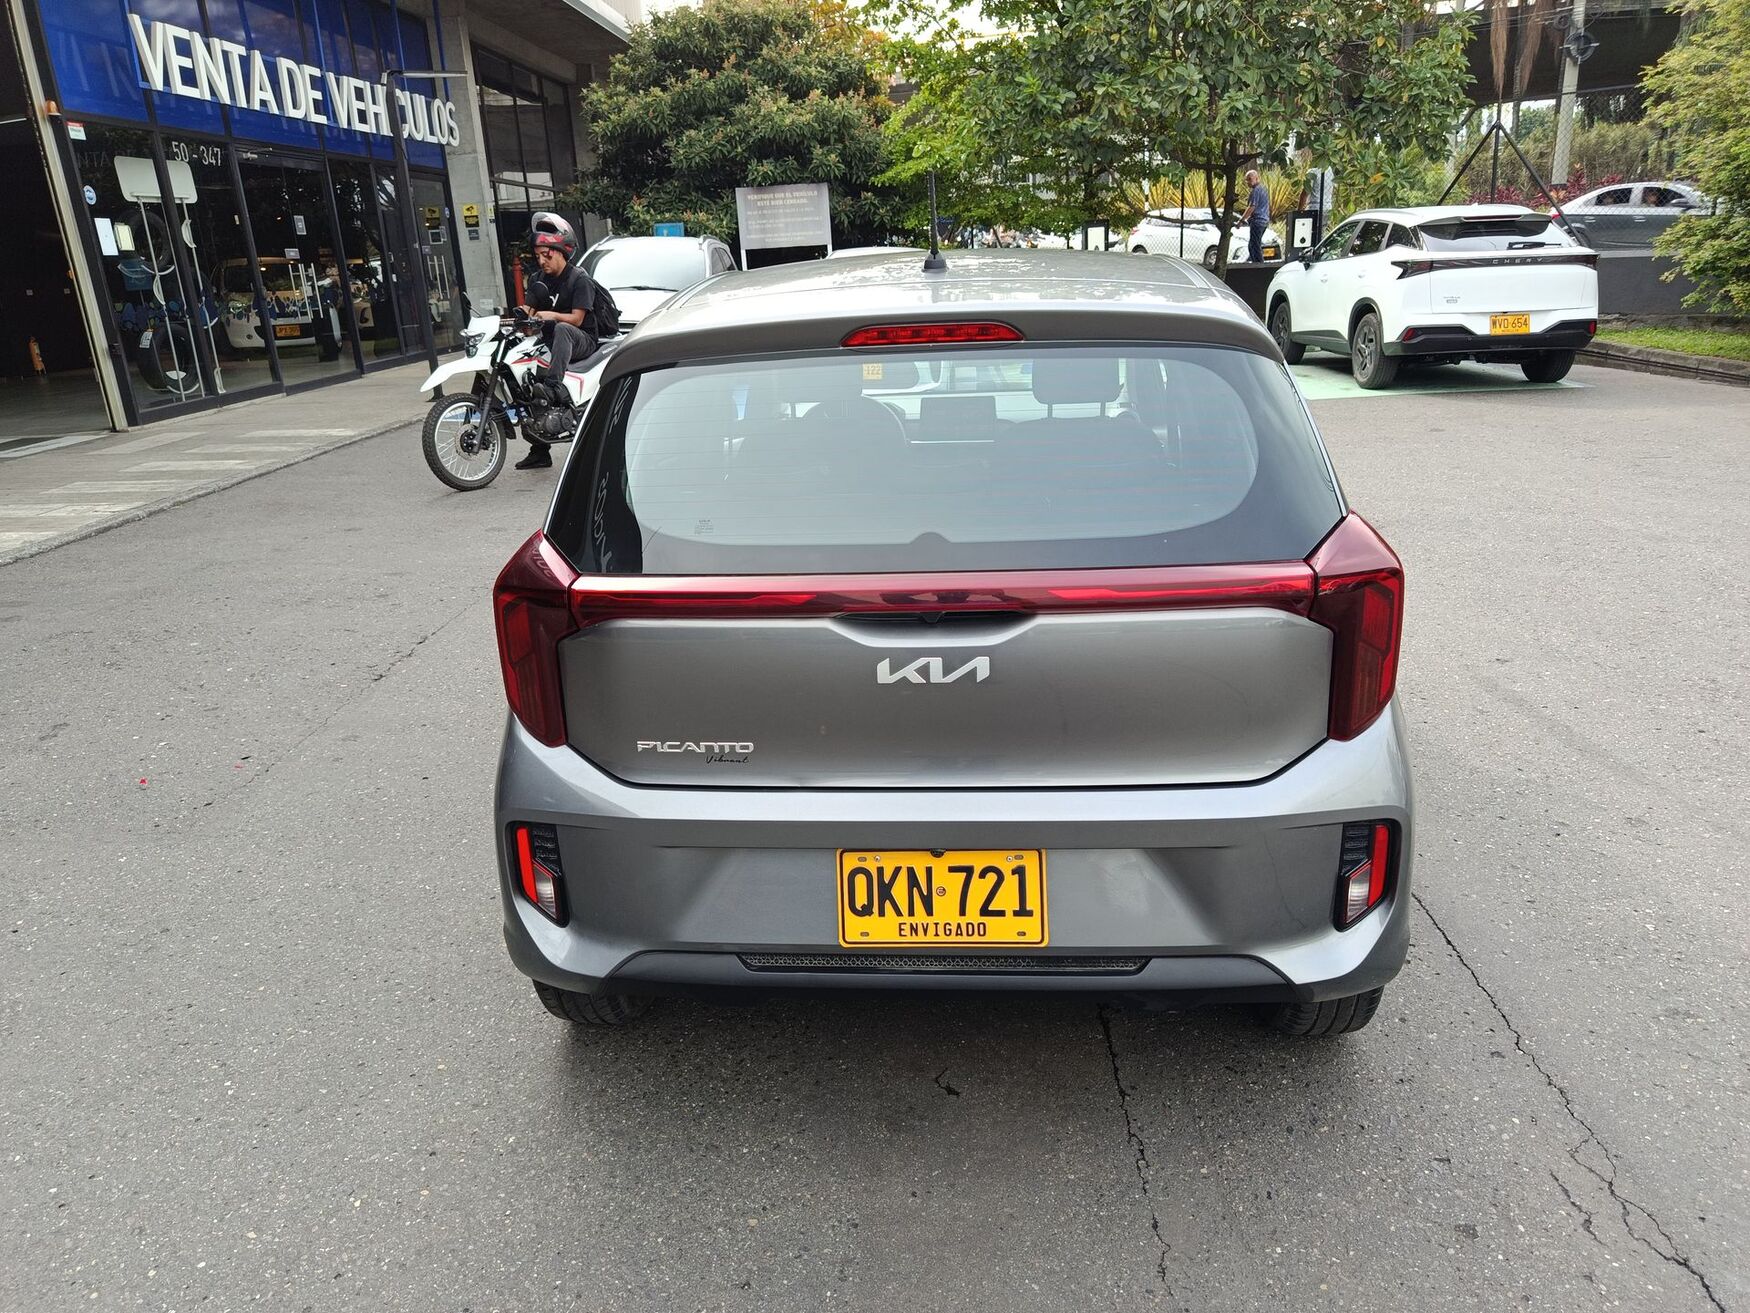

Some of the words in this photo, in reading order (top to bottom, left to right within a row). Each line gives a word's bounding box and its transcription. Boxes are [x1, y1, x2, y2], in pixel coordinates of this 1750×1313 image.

[127, 13, 279, 115] VENTA
[276, 56, 328, 124] DE
[324, 71, 460, 147] VEHCULOS
[171, 140, 190, 162] 50
[199, 144, 222, 167] 347
[1491, 257, 1543, 265] CHERY
[1511, 317, 1528, 329] 654
[876, 655, 990, 684] KIA
[636, 740, 754, 754] PICANTO
[705, 754, 749, 764] Vibrant
[847, 865, 935, 918] QKN
[947, 864, 1034, 918] 721
[897, 921, 987, 938] ENVIGADO
